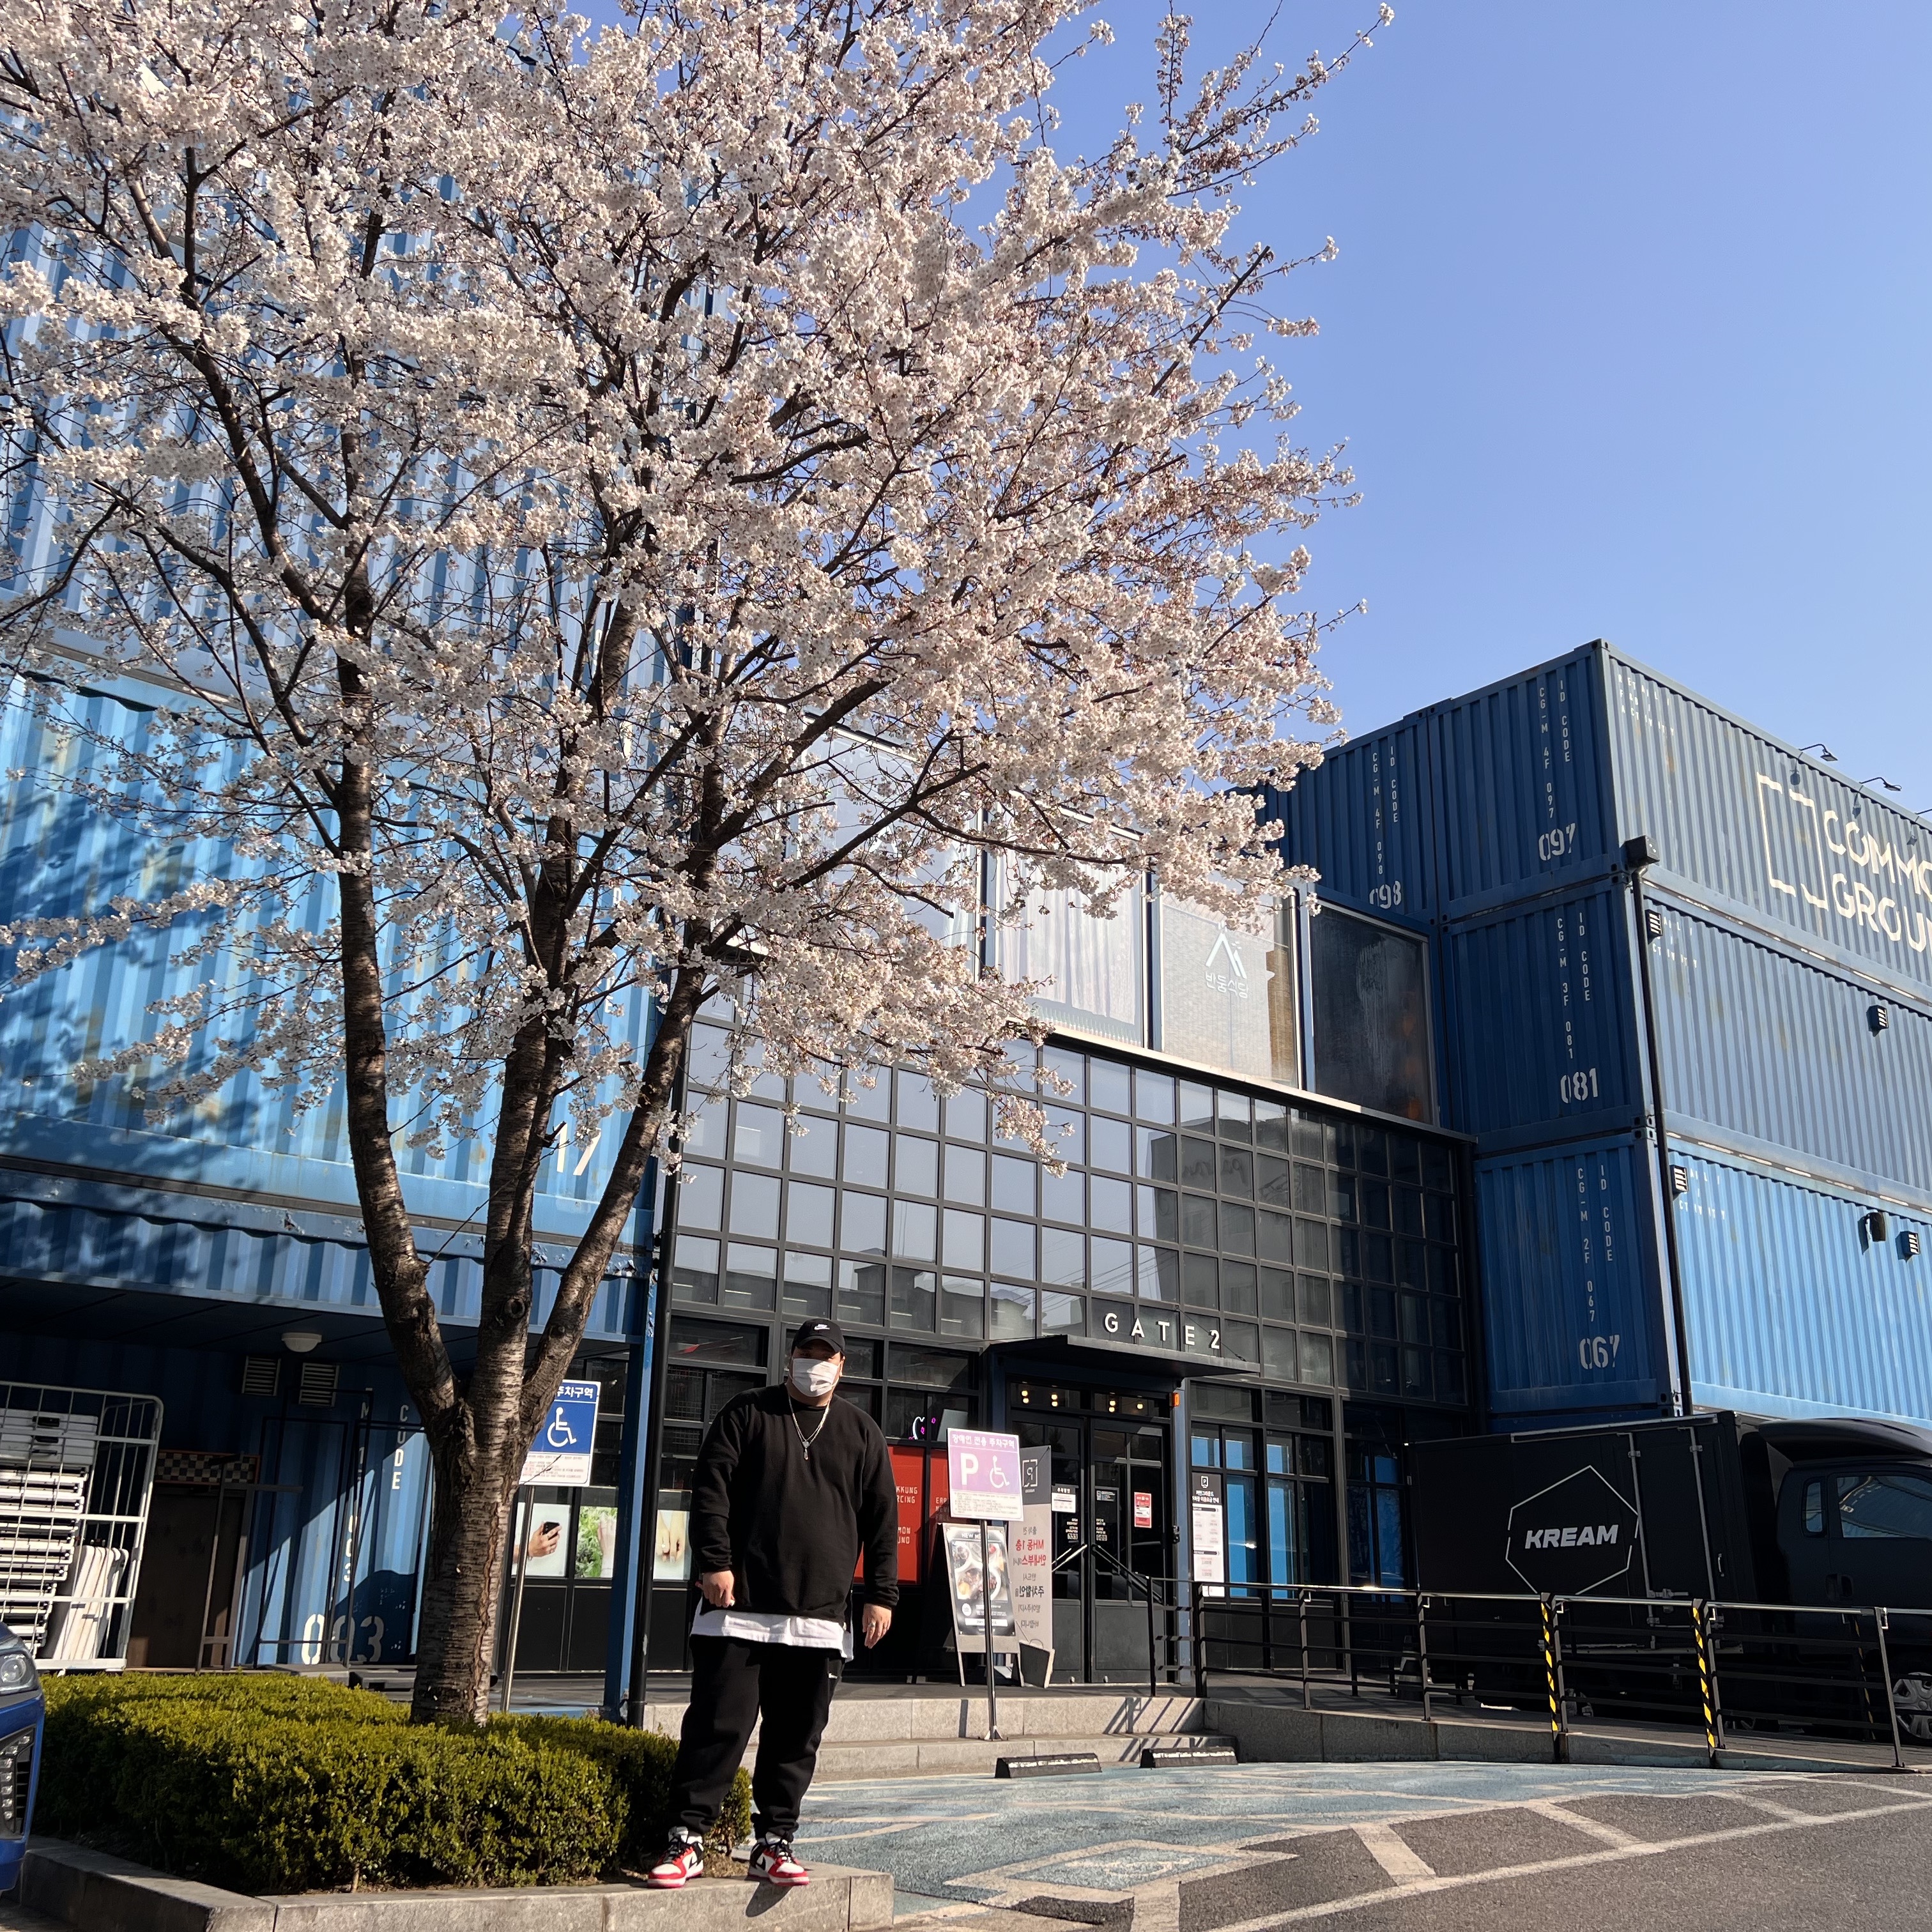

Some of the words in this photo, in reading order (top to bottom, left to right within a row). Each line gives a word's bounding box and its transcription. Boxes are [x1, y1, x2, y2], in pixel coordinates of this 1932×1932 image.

[1560, 680, 1565, 702] ID
[1539, 687, 1548, 733] CG-M
[1544, 746, 1550, 769] 4F
[1561, 716, 1570, 762] CODE
[1390, 746, 1395, 767] ID
[1375, 808, 1381, 829] 4F
[1538, 822, 1575, 861] 097
[1579, 912, 1585, 936] ID
[1664, 916, 1680, 931] AIL
[1832, 873, 1932, 953] GROU
[1557, 918, 1567, 968] CG-M
[1562, 982, 1569, 1006] 3F
[1652, 943, 1697, 968] CTIVITY
[1581, 951, 1591, 1001] CODE
[1560, 1068, 1598, 1104] 081
[1600, 1165, 1607, 1190] ID
[1690, 1168, 1708, 1182] AIL
[1578, 1168, 1588, 1222] CG-M
[1583, 1238, 1590, 1264] 2F
[1678, 1200, 1726, 1220] CTIVITY
[1603, 1206, 1613, 1262] CODE
[1104, 1312, 1195, 1346] GATE
[1209, 1330, 1220, 1349] 2
[1579, 1334, 1620, 1370] 067
[392, 1405, 409, 1490] CODE
[960, 1452, 979, 1485] P
[1524, 1524, 1618, 1549] KREAM
[302, 1614, 384, 1666] 003
